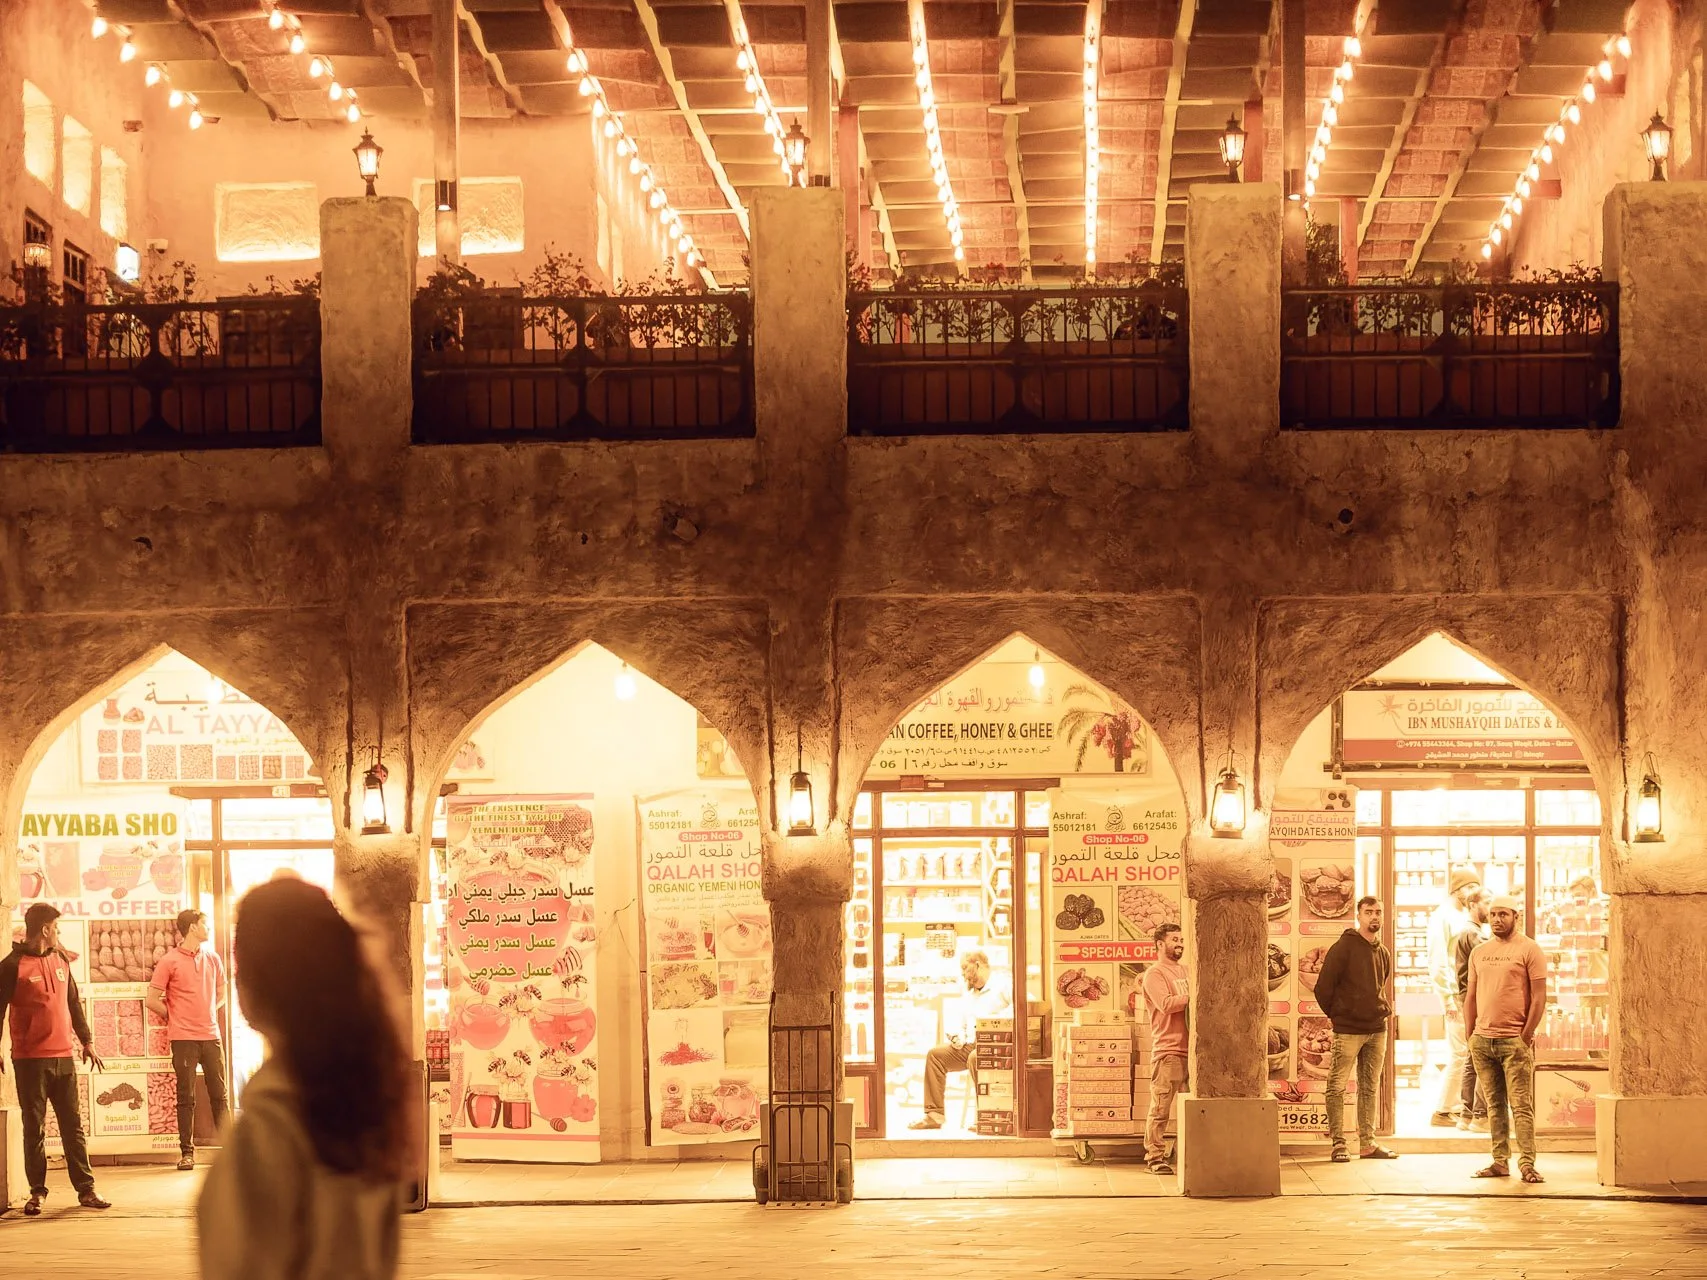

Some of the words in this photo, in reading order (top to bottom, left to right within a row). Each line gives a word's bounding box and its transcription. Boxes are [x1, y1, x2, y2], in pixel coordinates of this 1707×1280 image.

[146, 715, 184, 734] AL
[194, 714, 291, 734] TAYYA
[886, 724, 905, 738] AN
[908, 723, 958, 741] COFFEE,
[961, 723, 1004, 738] HONEY
[1007, 723, 1016, 738] &
[1019, 723, 1053, 738] GHEE
[1408, 717, 1428, 729] IBN
[1431, 717, 1501, 731] MUSHAYQIH
[1504, 717, 1540, 729] DATES
[1544, 717, 1552, 729] &
[648, 810, 682, 818] Ashraf:
[1053, 812, 1087, 820] Ashraf:
[1145, 810, 1177, 818] Arafat:
[22, 813, 119, 836] AYYABA
[649, 821, 692, 830] 55012181
[727, 819, 759, 827] 661254
[1053, 823, 1096, 832] 55012181
[1133, 822, 1177, 831] 66125436
[1270, 827, 1297, 837] AYQIH
[1298, 827, 1326, 836] DATES
[1328, 828, 1333, 836] &
[682, 832, 708, 841] Shop
[711, 831, 739, 840] No-06
[1086, 835, 1112, 845] Shop
[1115, 834, 1145, 844] No-06
[647, 843, 691, 863] التمور
[699, 842, 733, 857] قلعة
[1052, 846, 1096, 866] التمور
[1104, 846, 1139, 860] قلعة
[1147, 845, 1180, 862] محل
[647, 863, 714, 881] QALAH
[1052, 866, 1118, 883] QALAH
[1125, 865, 1180, 881] SHOP
[463, 883, 492, 904] يمني
[497, 883, 526, 903] جبلي
[532, 886, 558, 900] سدر
[564, 882, 594, 899] عسل
[648, 882, 695, 893] ORGANIC
[698, 880, 737, 891] YEMENI
[739, 880, 761, 890] HON
[459, 908, 490, 929] ملكي
[495, 912, 521, 926] سدر
[526, 908, 558, 925] عسل
[460, 935, 489, 954] يمني
[494, 938, 520, 951] سدر
[525, 934, 556, 951] عسل
[1081, 946, 1131, 959] SPECIAL
[1134, 946, 1157, 958] OFF
[469, 963, 516, 982] حضرمي
[522, 962, 552, 979] عسل
